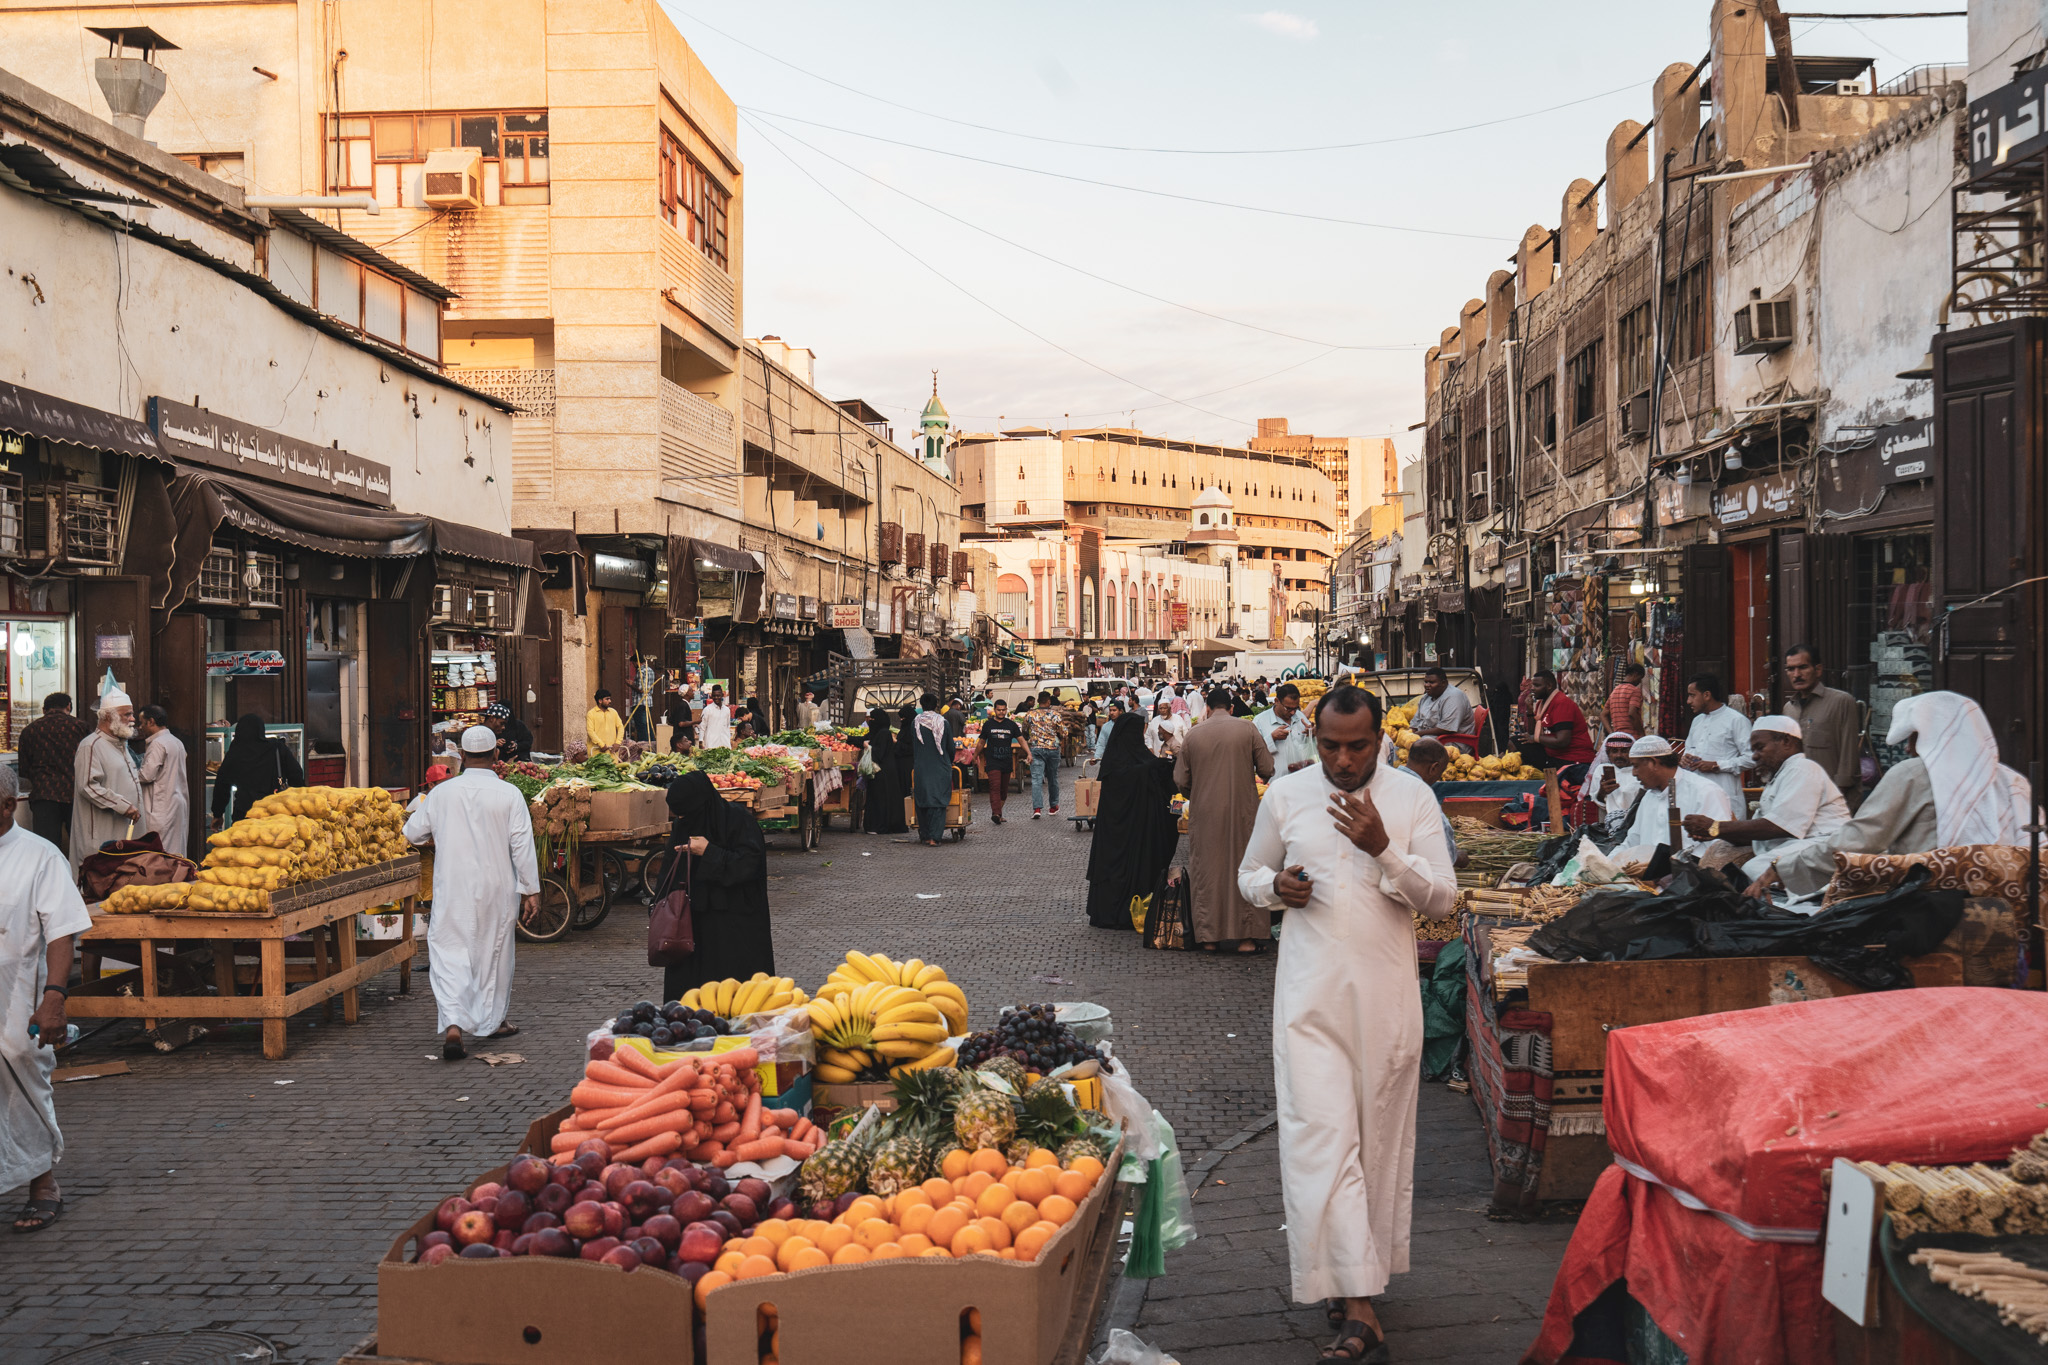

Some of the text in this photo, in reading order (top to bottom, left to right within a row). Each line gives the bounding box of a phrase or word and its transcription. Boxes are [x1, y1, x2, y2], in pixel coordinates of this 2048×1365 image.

[163, 409, 389, 496] مطعم البصلي للأسماك والمأكولات الشعبية
[1881, 422, 1934, 465] السعدي
[1713, 490, 1743, 519] للعطارة
[834, 618, 860, 627] SHOES
[243, 653, 284, 671] سنبوسة
